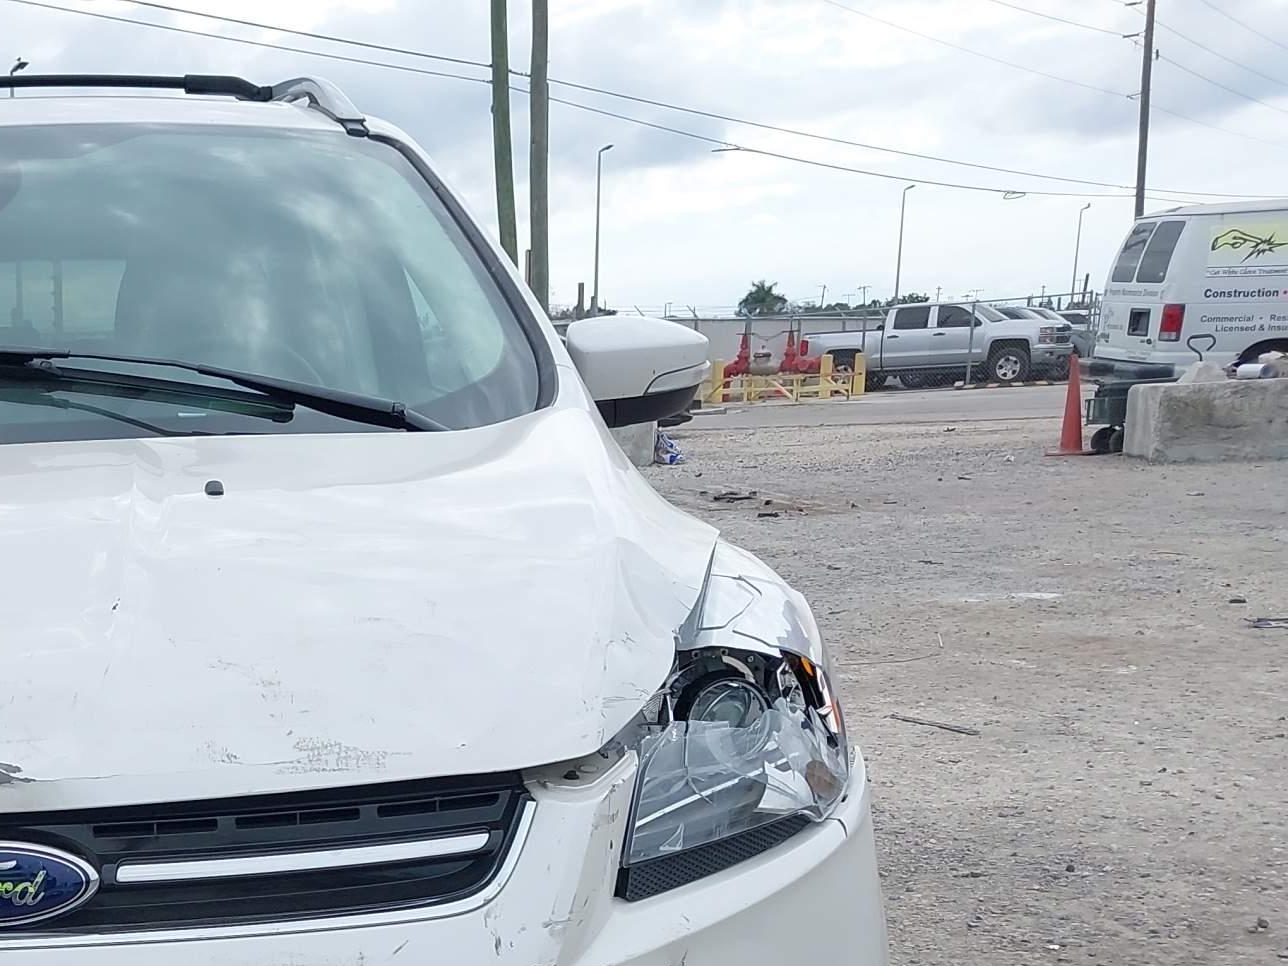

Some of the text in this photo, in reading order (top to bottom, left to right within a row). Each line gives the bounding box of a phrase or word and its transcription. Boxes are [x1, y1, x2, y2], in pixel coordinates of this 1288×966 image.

[1203, 287, 1280, 299] Construction
[1200, 314, 1254, 322] Commercial
[1215, 324, 1257, 332] Licensed
